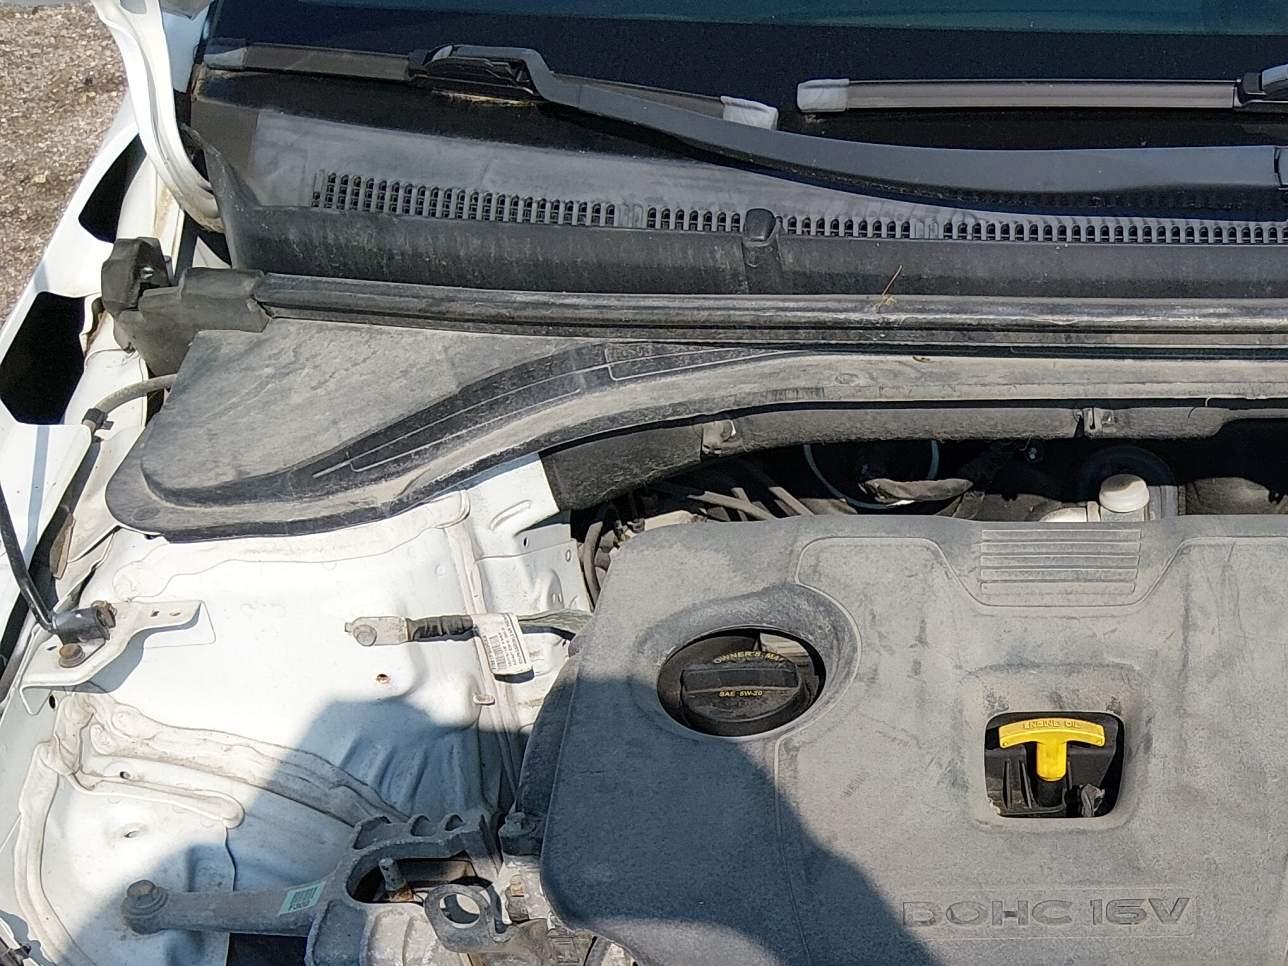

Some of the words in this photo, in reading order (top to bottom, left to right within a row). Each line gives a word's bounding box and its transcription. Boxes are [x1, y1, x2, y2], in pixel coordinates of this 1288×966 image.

[1023, 720, 1060, 729] ENGINE
[1064, 720, 1081, 728] OIL
[902, 899, 1073, 927] DOHC
[1090, 897, 1190, 926] 16V
